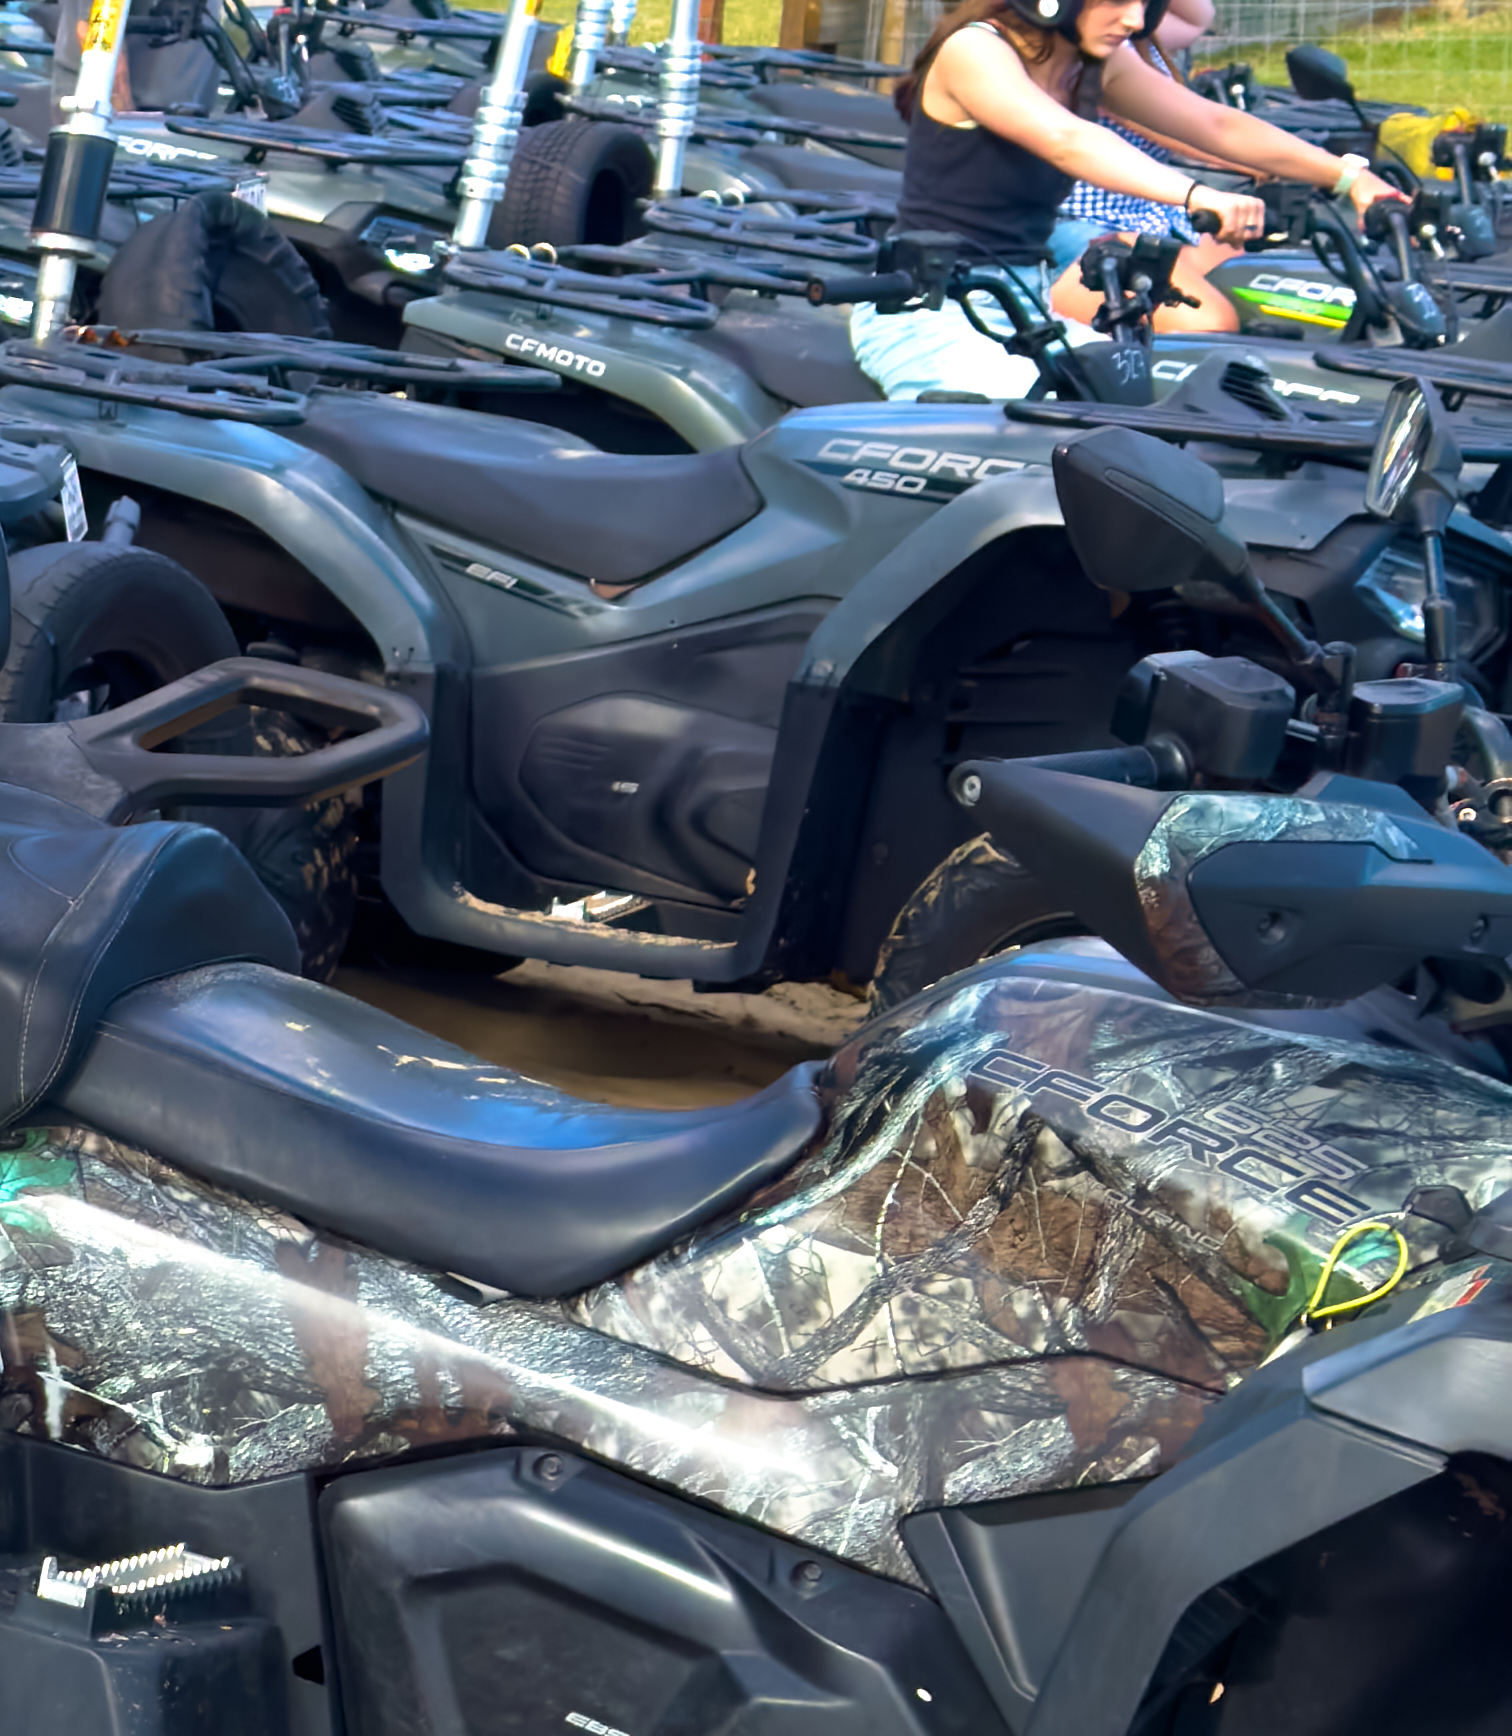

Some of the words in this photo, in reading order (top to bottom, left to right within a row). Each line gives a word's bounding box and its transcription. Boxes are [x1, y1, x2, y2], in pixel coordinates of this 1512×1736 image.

[1249, 273, 1358, 307] CFOR
[505, 332, 606, 377] CFMOTO
[817, 438, 1042, 481] CFORC
[841, 468, 928, 494] 450
[465, 562, 519, 589] EFI
[968, 1047, 1373, 1227] CFORCE
[1203, 1100, 1370, 1181] 625
